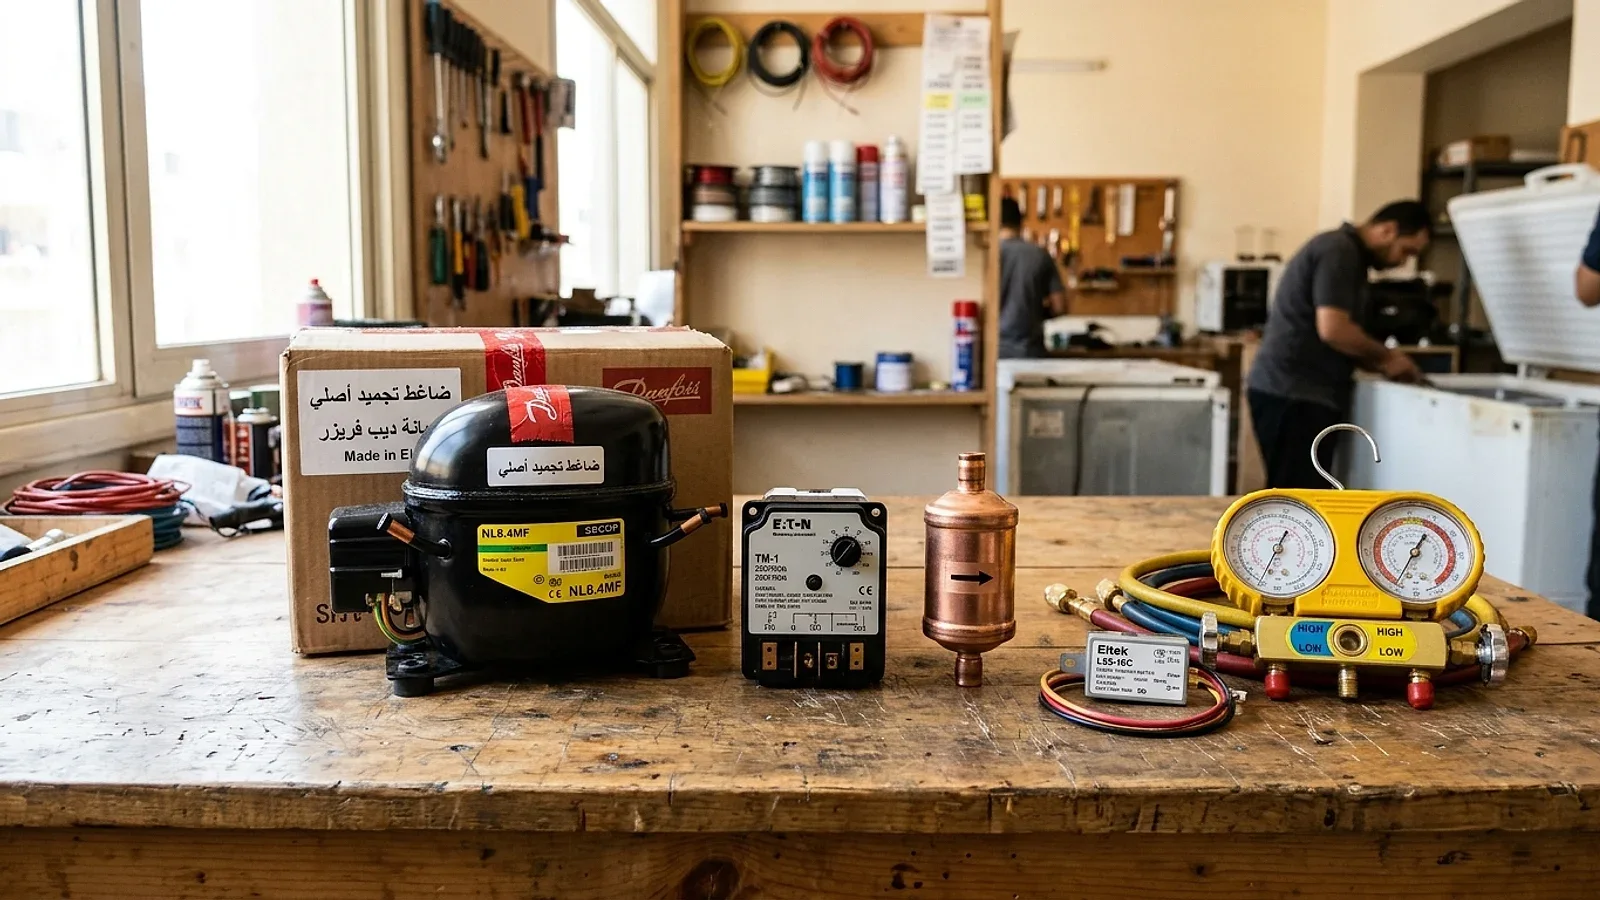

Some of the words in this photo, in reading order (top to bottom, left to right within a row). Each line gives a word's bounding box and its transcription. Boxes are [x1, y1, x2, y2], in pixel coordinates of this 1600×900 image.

[310, 384, 351, 410] أصلي
[357, 387, 400, 405] تجميد
[403, 384, 451, 401] ضاغط
[318, 419, 363, 441] فريزر
[367, 422, 397, 439] ديب
[344, 450, 380, 462] Made
[384, 449, 396, 461] in
[498, 459, 528, 478] أصلي
[532, 460, 563, 475] تجميد
[566, 459, 600, 472] ضاغط
[481, 528, 530, 538] NL8.4MF
[755, 554, 779, 563] TM-1
[569, 581, 622, 597] NL8.4MF
[1377, 627, 1403, 637] HIGH
[1097, 644, 1129, 656] Eltek
[1298, 643, 1322, 653] LOW
[1379, 647, 1404, 657] LOW
